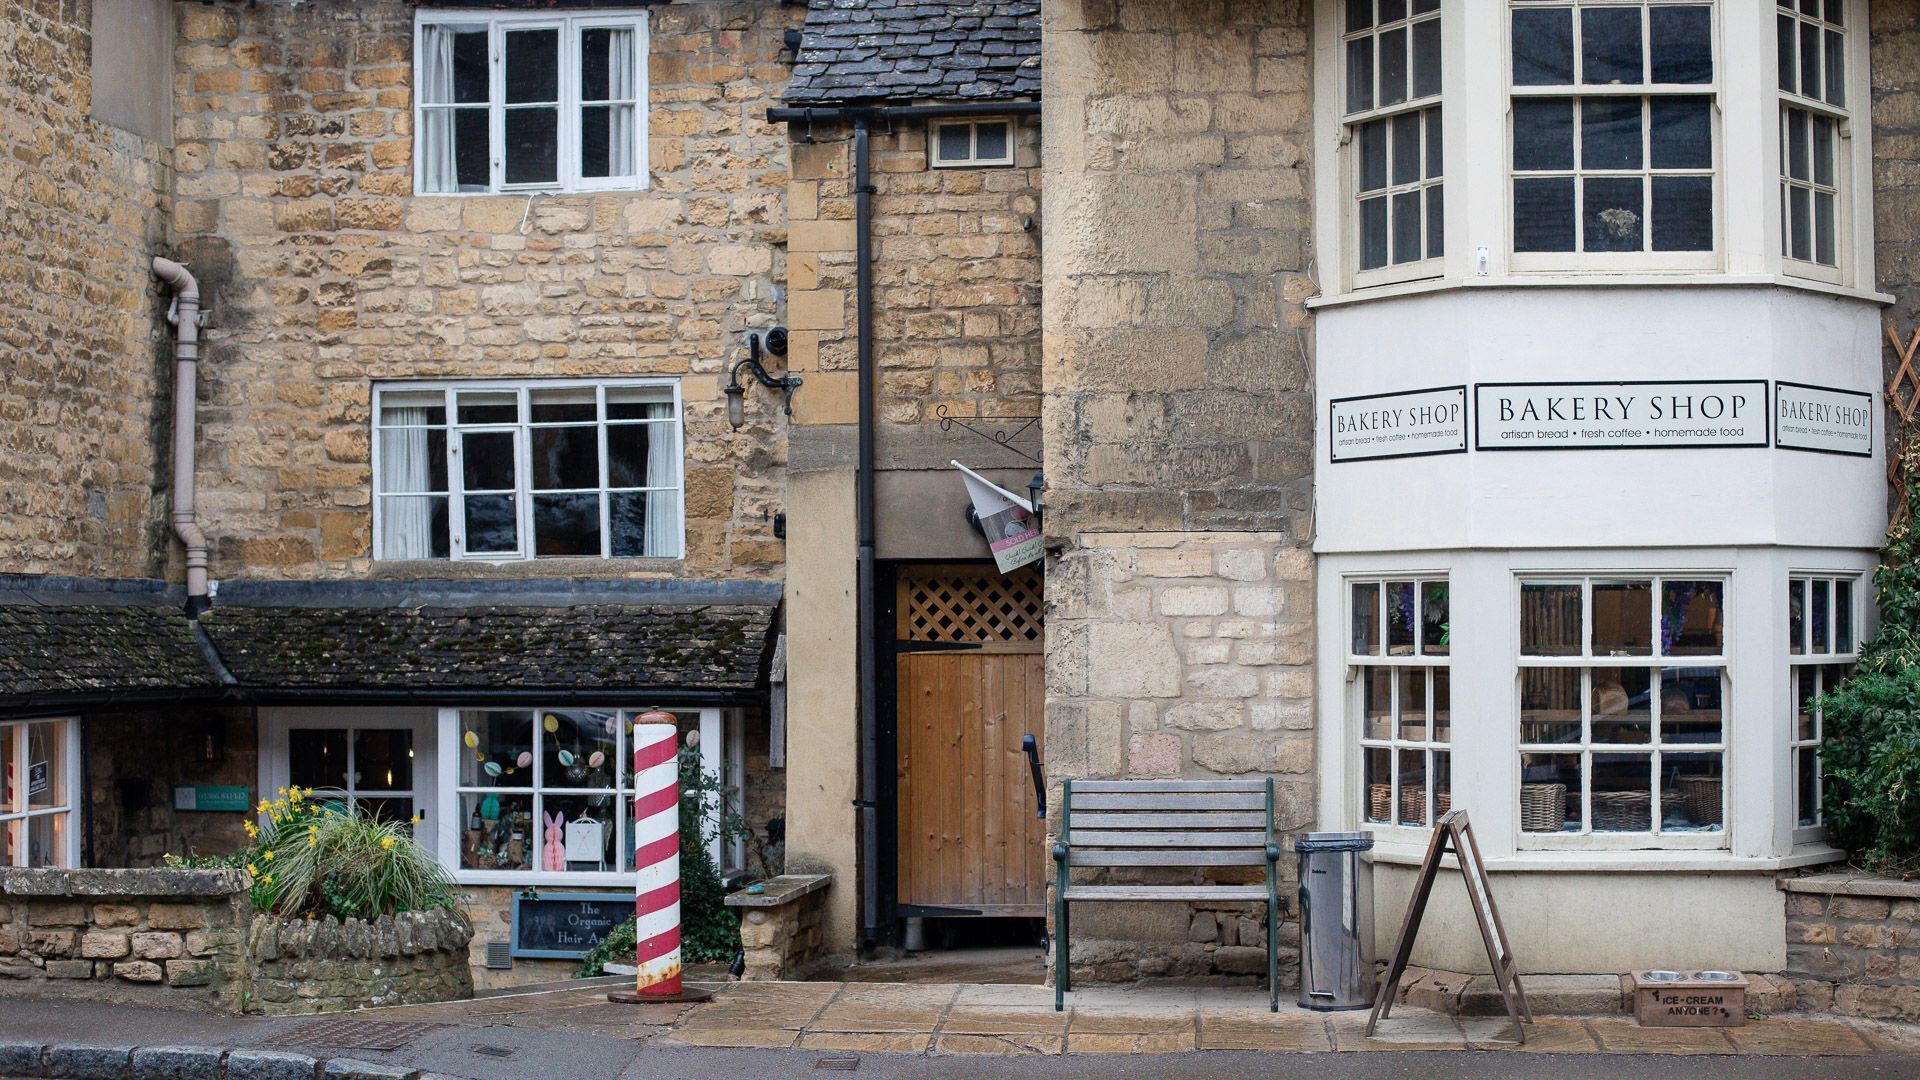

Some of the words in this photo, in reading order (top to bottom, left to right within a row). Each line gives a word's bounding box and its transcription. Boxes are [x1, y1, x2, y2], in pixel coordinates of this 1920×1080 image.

[1499, 396, 1637, 421] BAKERY
[1650, 395, 1746, 420] SHOP
[1782, 400, 1831, 422] BAKERY
[1836, 405, 1868, 427] SHOP
[1338, 409, 1402, 433] BAKERY
[1409, 403, 1459, 426] SHOP
[1355, 436, 1371, 445] bread
[1375, 434, 1388, 443] fresh
[1389, 433, 1406, 442] coffee
[1411, 430, 1444, 439] homemade
[1444, 428, 1458, 436] food
[1501, 429, 1534, 439] artisan
[1537, 428, 1569, 439] bread
[1581, 428, 1605, 438] fresh
[1607, 427, 1642, 438] coffee
[1654, 427, 1717, 437] homemade
[1719, 426, 1744, 436] food
[1005, 535, 1024, 547] SOLD
[1025, 529, 1040, 540] HER
[580, 902, 600, 914] The
[568, 913, 611, 930] Organic
[557, 931, 583, 944] Hair
